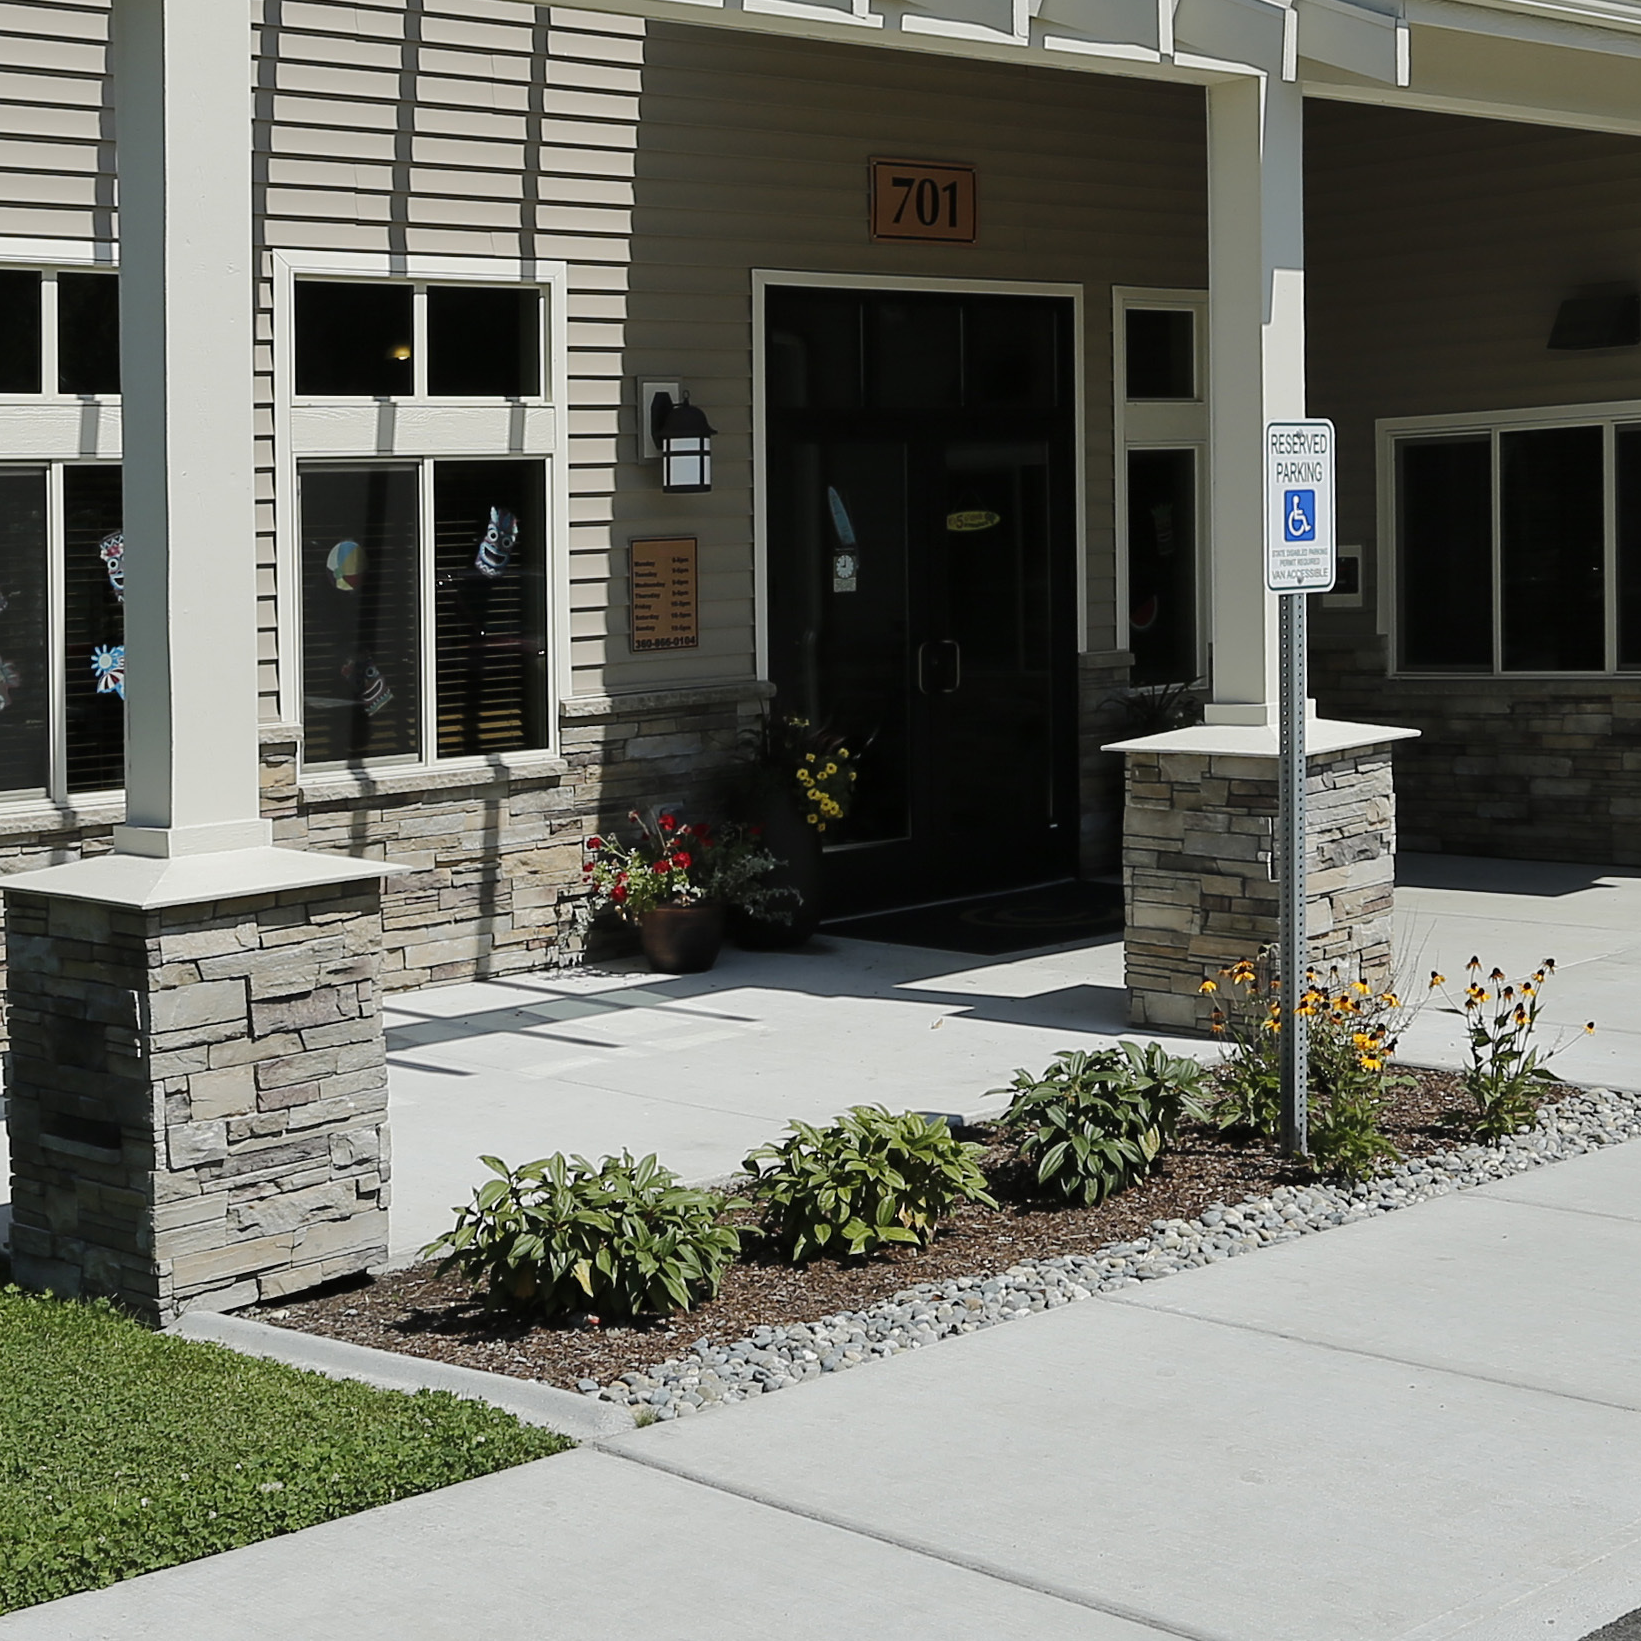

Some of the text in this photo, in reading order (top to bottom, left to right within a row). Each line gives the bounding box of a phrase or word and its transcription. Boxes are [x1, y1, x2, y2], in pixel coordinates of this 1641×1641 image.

[892, 177, 957, 228] 701
[1271, 433, 1327, 455] RESERVED
[1276, 461, 1323, 483] PARKING
[1272, 570, 1286, 580] VAN
